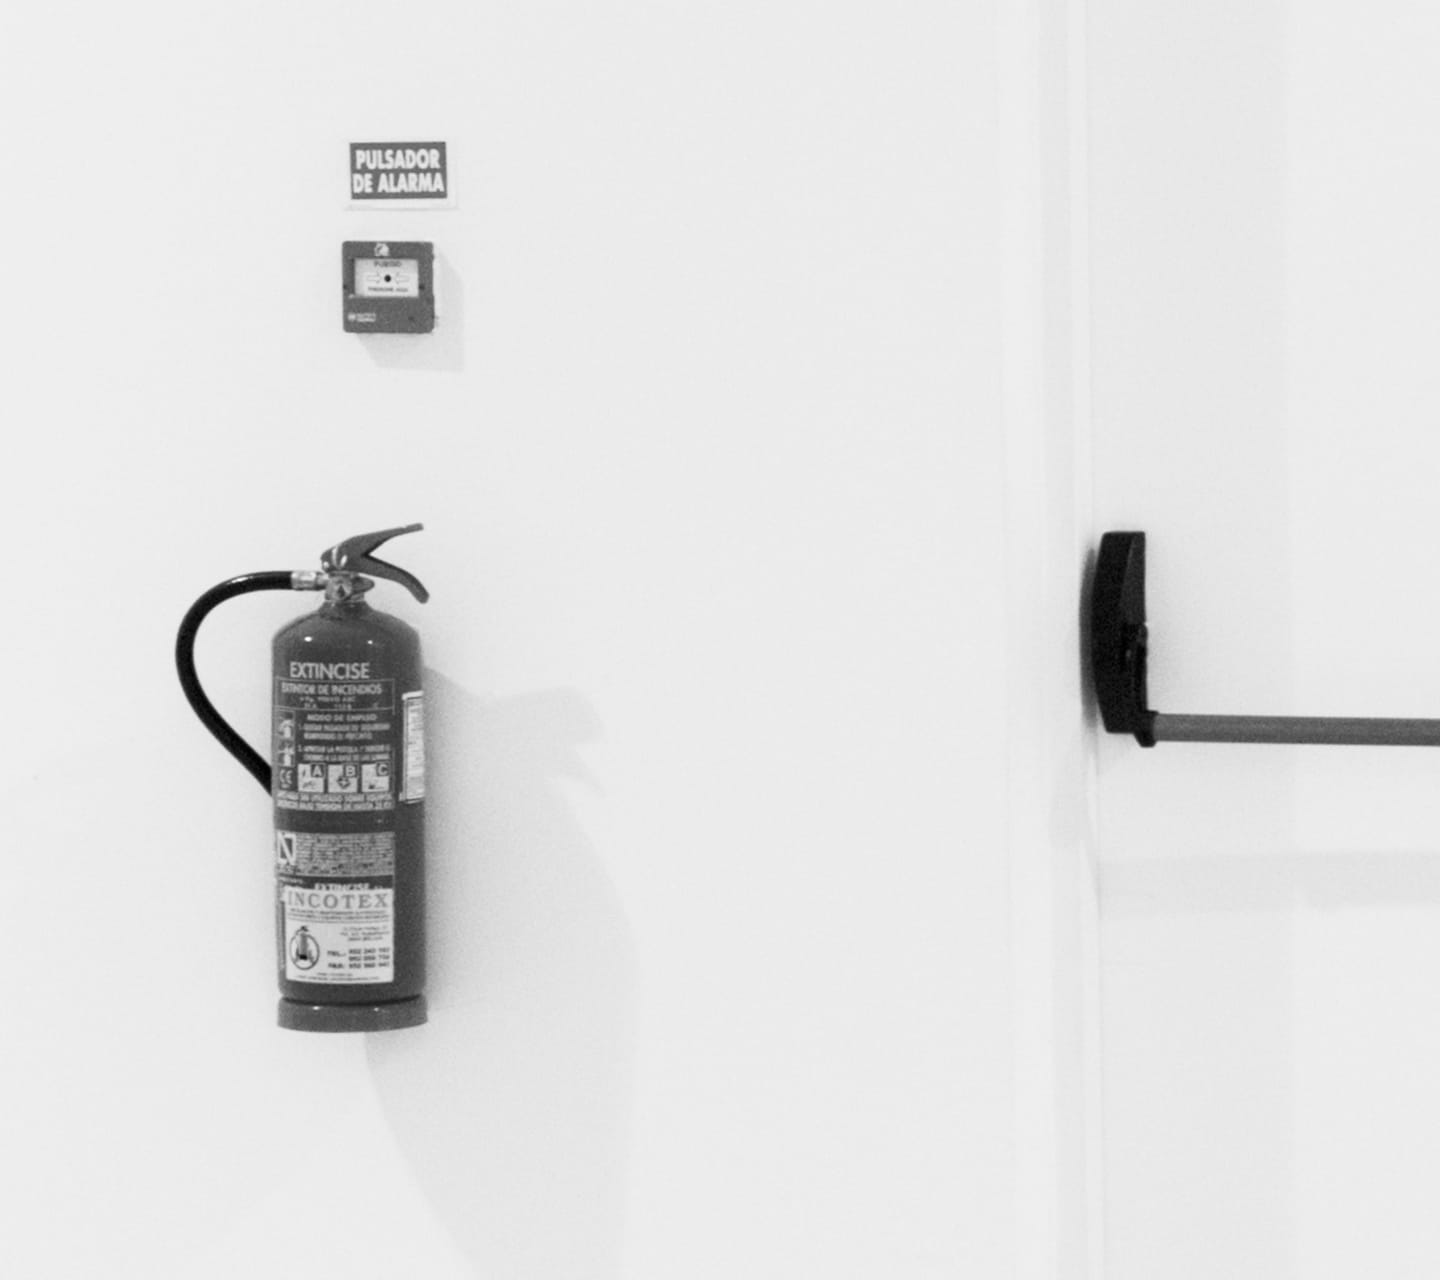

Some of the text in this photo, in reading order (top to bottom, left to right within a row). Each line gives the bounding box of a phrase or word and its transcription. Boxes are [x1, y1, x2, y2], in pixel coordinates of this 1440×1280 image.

[355, 149, 440, 170] PULSADOR
[353, 172, 445, 193] DE ALARMA
[289, 662, 370, 680] EXTINCISE
[312, 765, 322, 776] A
[345, 766, 356, 777] B
[378, 764, 389, 775] C
[288, 891, 388, 909] INCOTEX
